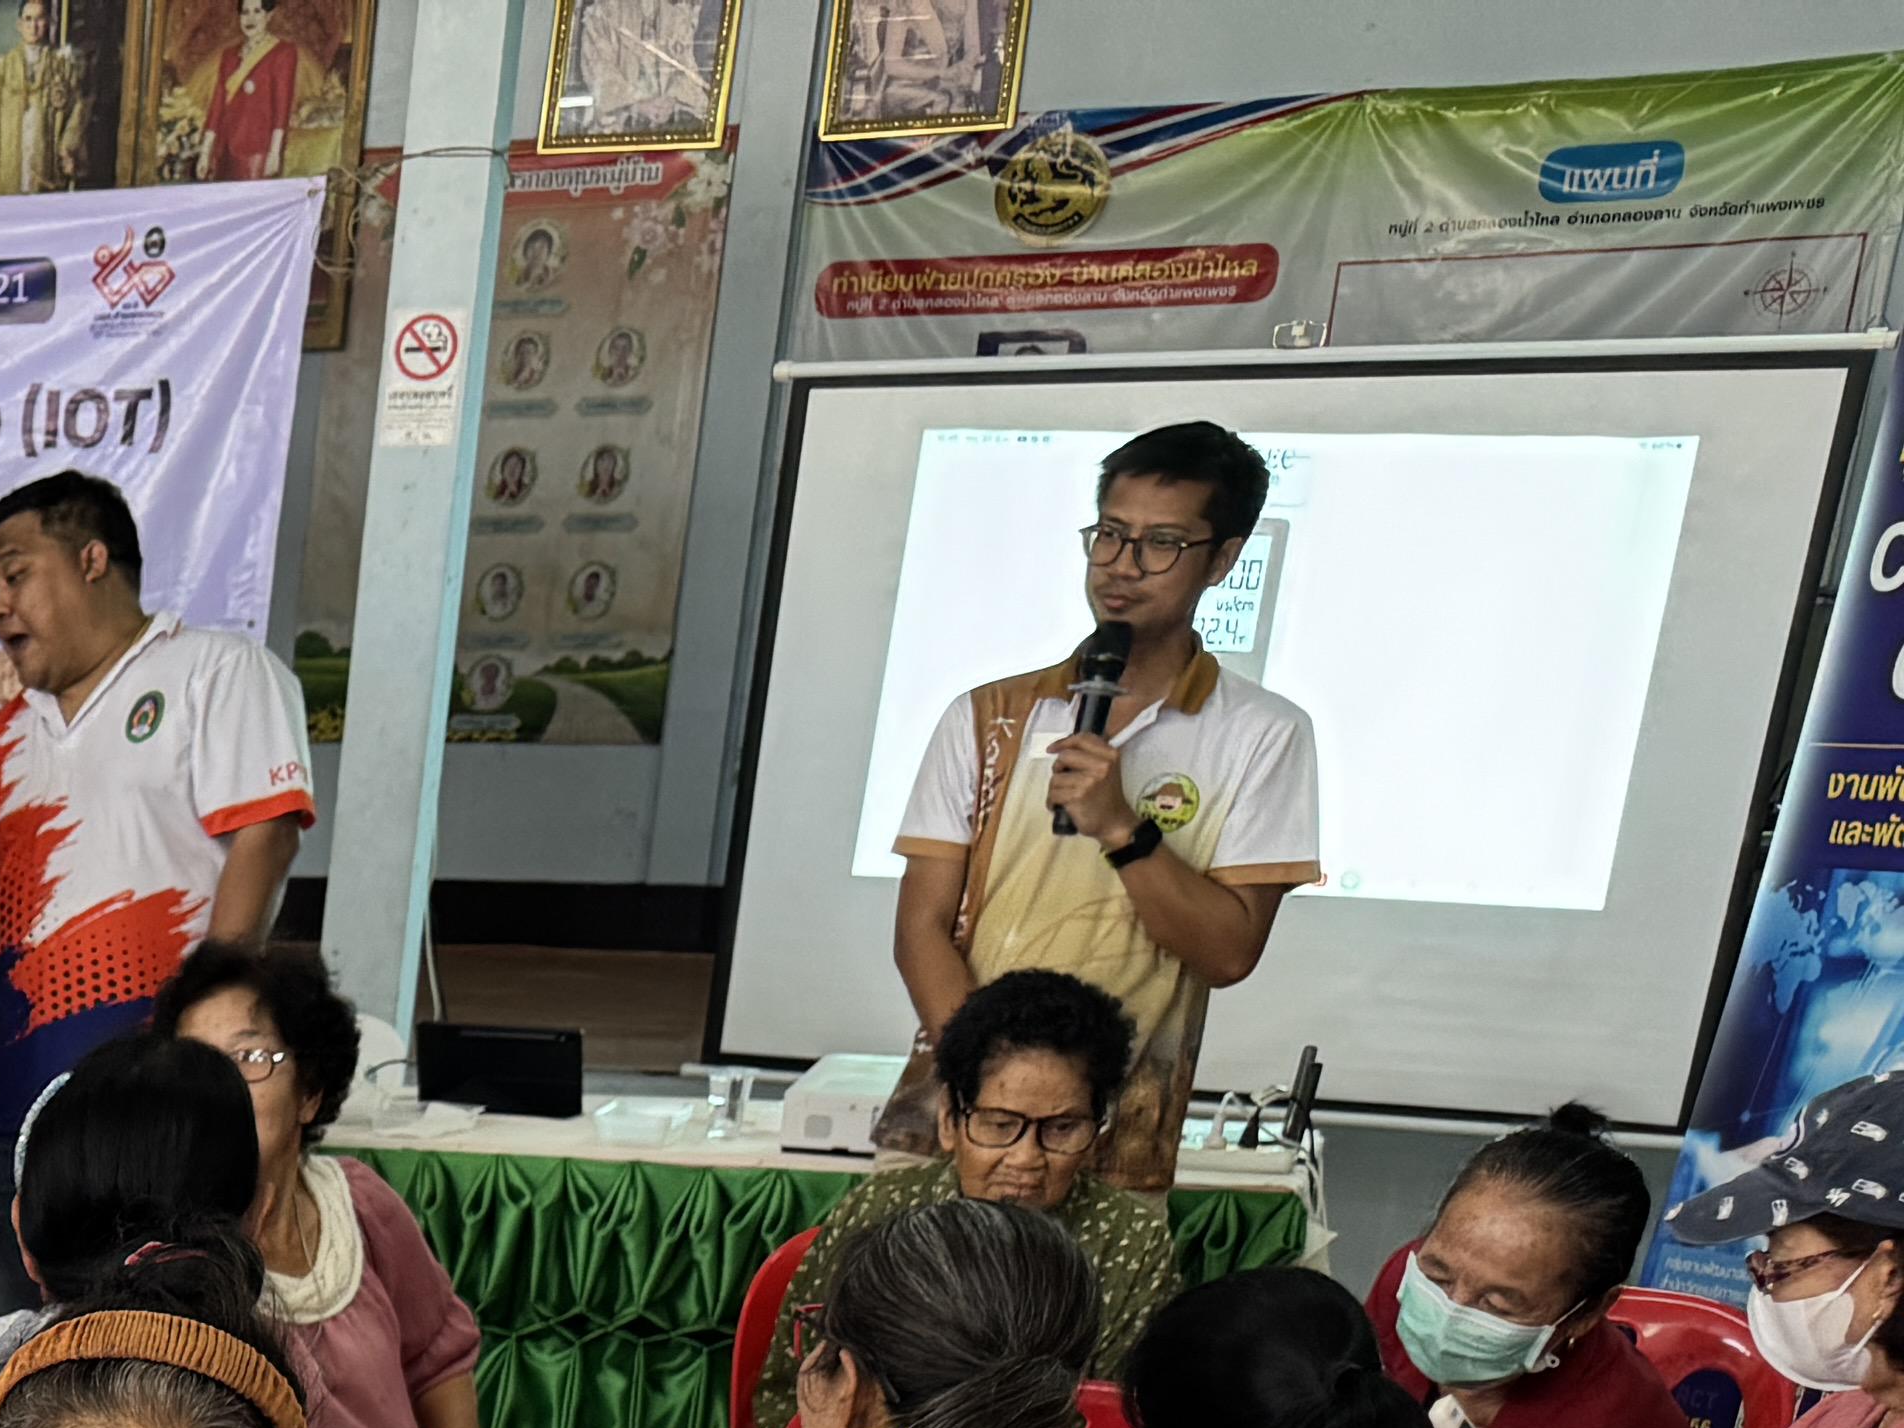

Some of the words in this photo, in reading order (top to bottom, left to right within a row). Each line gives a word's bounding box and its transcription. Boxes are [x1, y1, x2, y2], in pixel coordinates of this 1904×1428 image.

[1562, 150, 1661, 193] แผนที่
[22, 380, 171, 457] (IOT)
